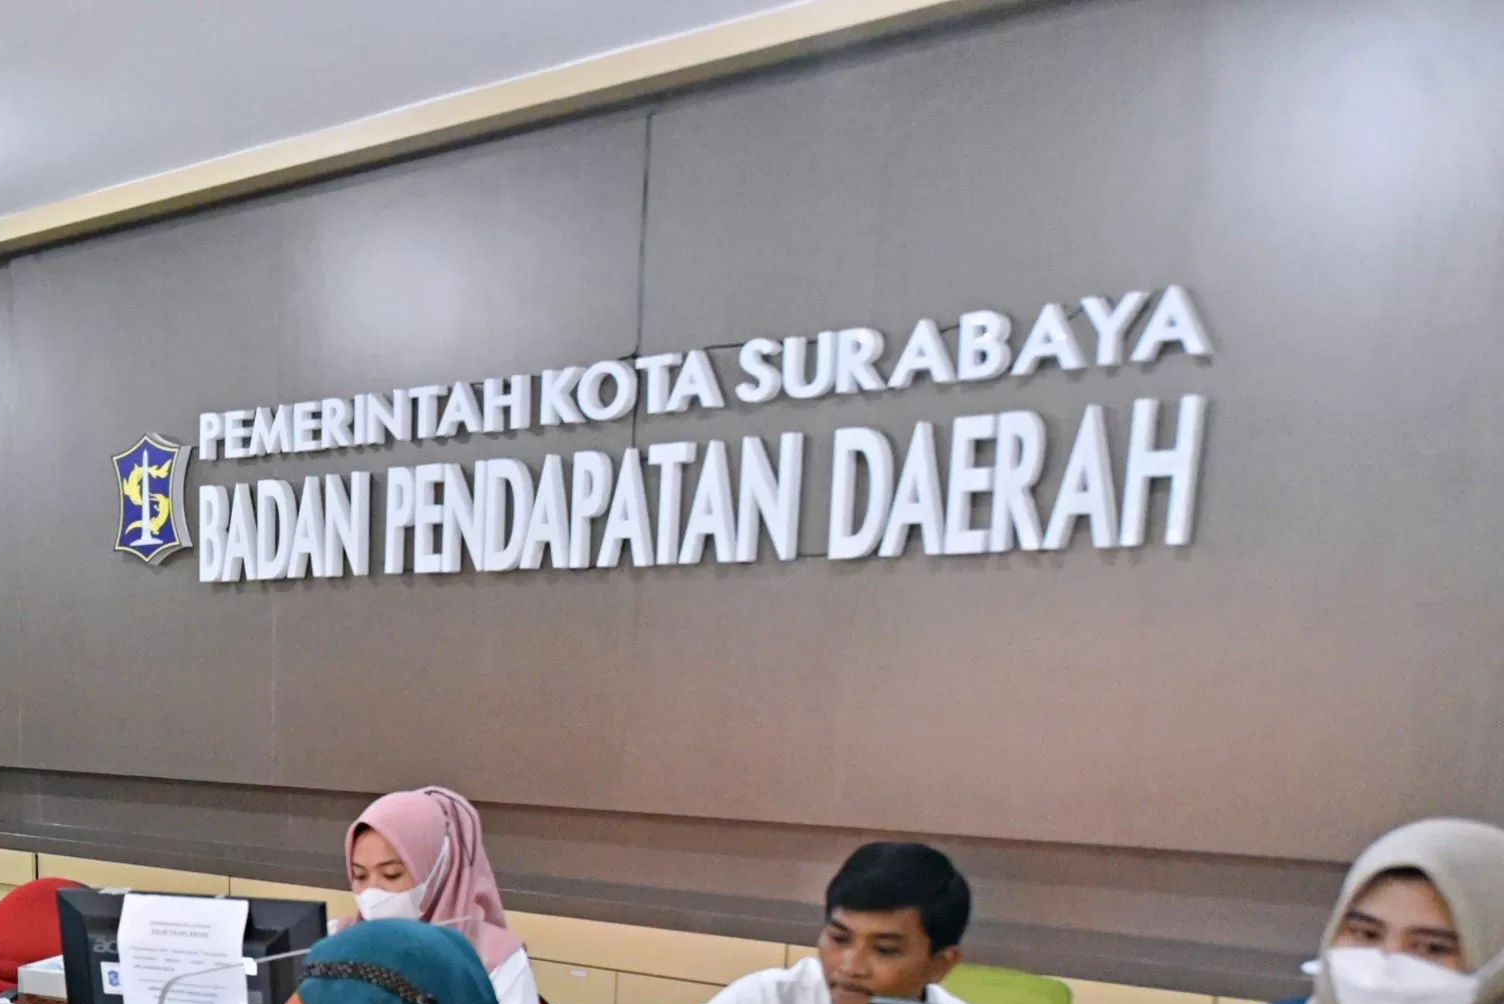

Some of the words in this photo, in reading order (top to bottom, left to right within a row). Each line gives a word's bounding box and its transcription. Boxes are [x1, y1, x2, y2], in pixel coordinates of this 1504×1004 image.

[199, 374, 532, 461] PEMERINTAH
[540, 349, 725, 426] KOTA
[735, 284, 1212, 402] SURABAYA
[199, 471, 371, 582] BADAN
[385, 431, 804, 575] PENDAPATAN
[827, 394, 1207, 560] DAERAH
